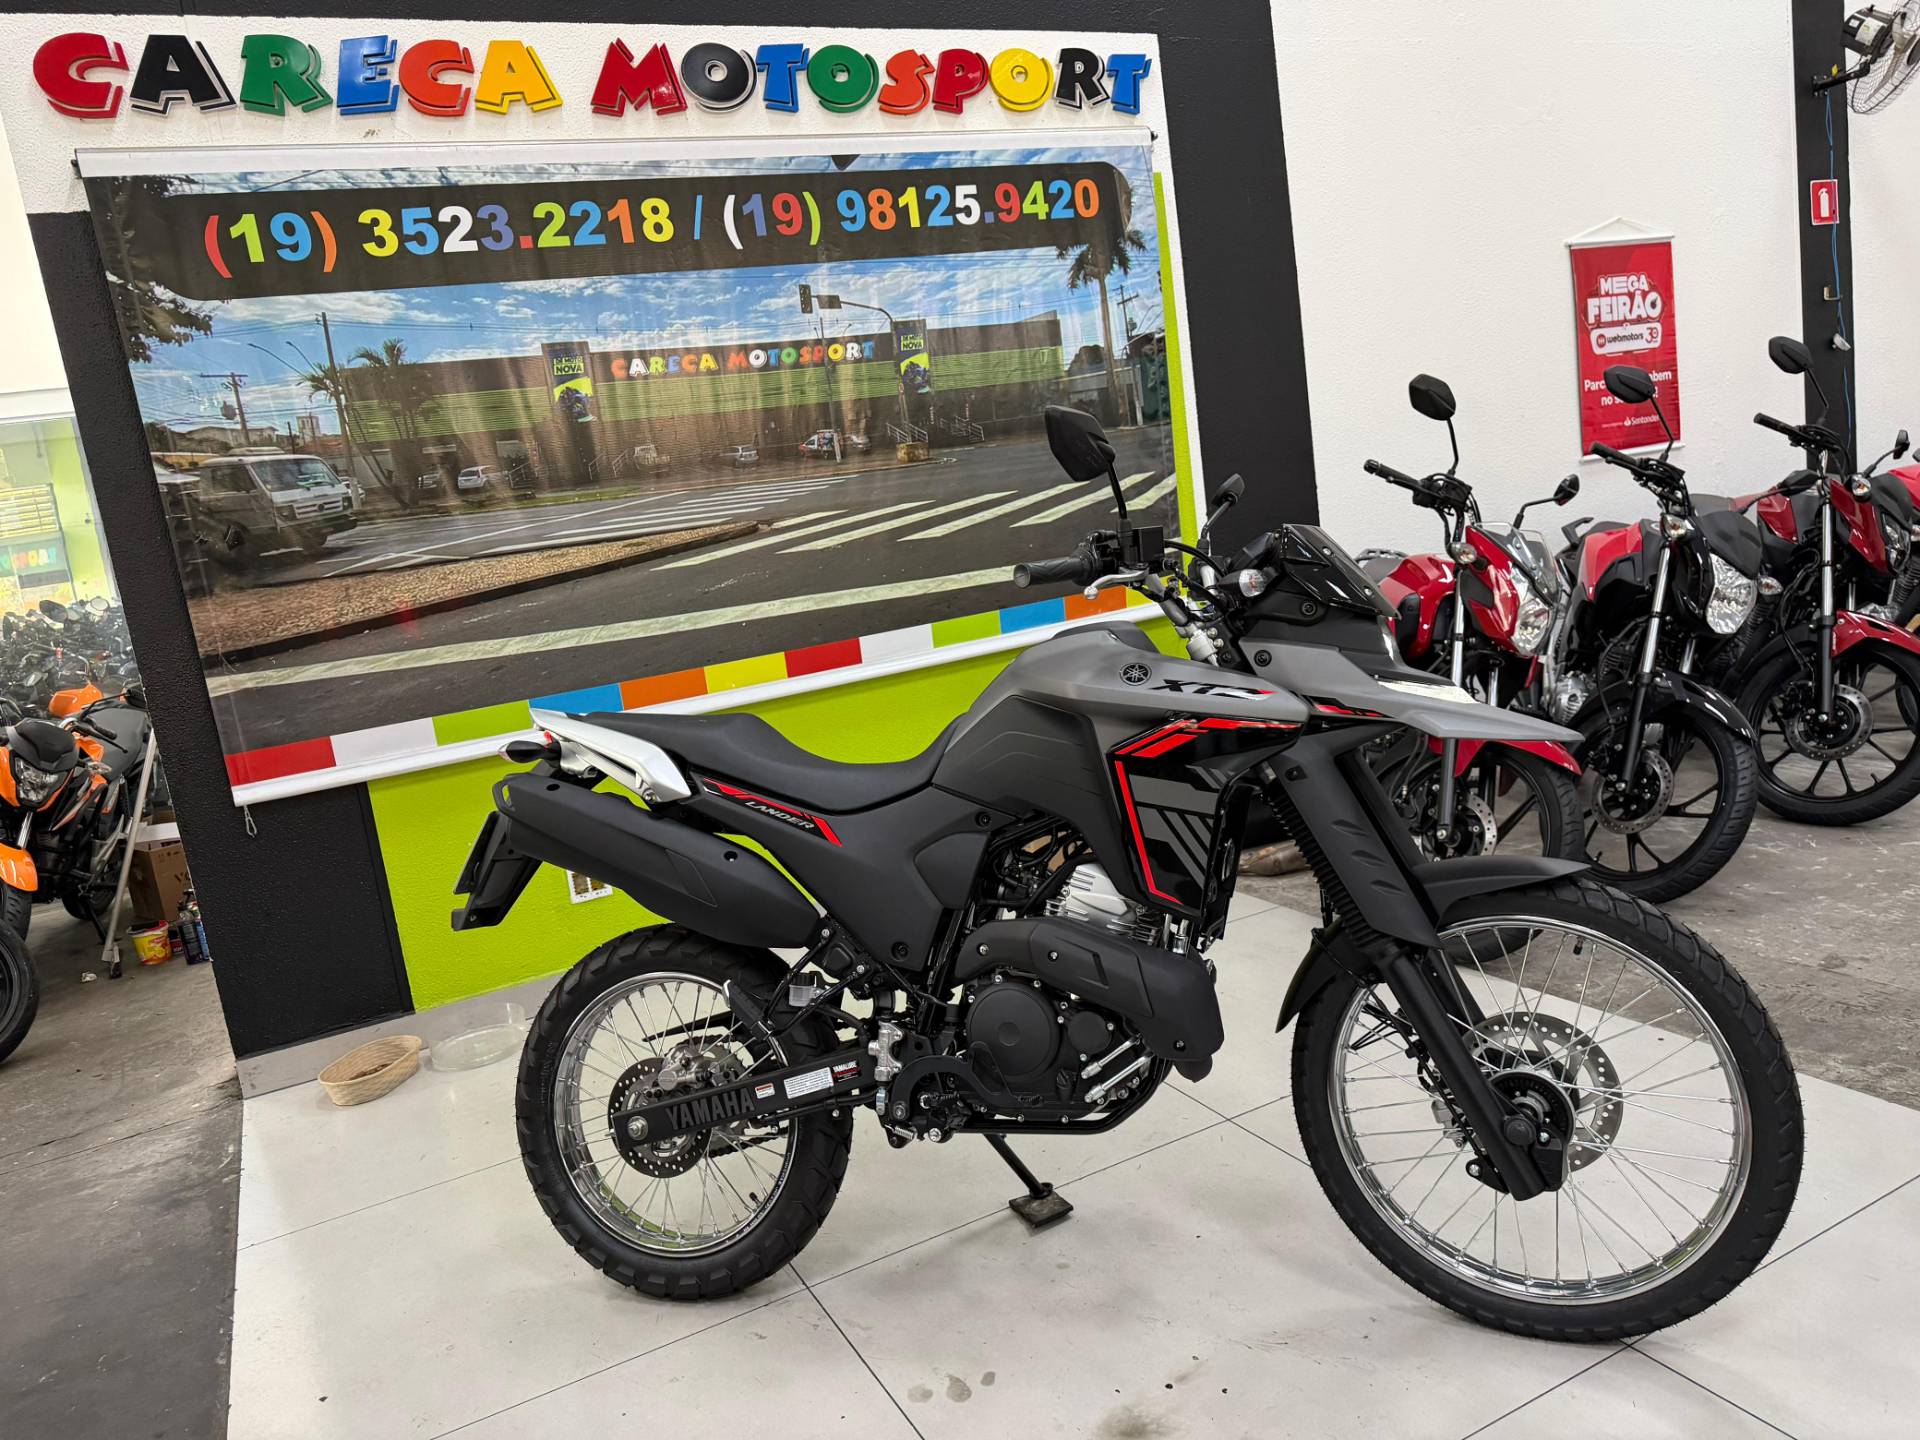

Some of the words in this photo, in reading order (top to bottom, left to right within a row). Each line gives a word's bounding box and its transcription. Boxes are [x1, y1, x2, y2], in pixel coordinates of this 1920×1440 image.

[32, 32, 282, 118] CARECA
[591, 38, 1151, 116] MOTOSPORT
[205, 210, 337, 279] (19)
[357, 198, 675, 258] 3523.2218
[723, 191, 822, 249] (19)
[837, 179, 1100, 232] 98125.9420
[1600, 274, 1649, 295] MEGA
[1587, 289, 1662, 324] FEIRÃO
[1607, 332, 1644, 344] webmotors
[556, 365, 582, 374] NOVA
[611, 353, 719, 378] CARECA
[727, 340, 875, 369] MOTOSPORT
[1601, 396, 1613, 405] no
[1631, 415, 1660, 425] Santande
[744, 801, 815, 829] LANDER
[665, 1087, 755, 1130] YAMAHA
